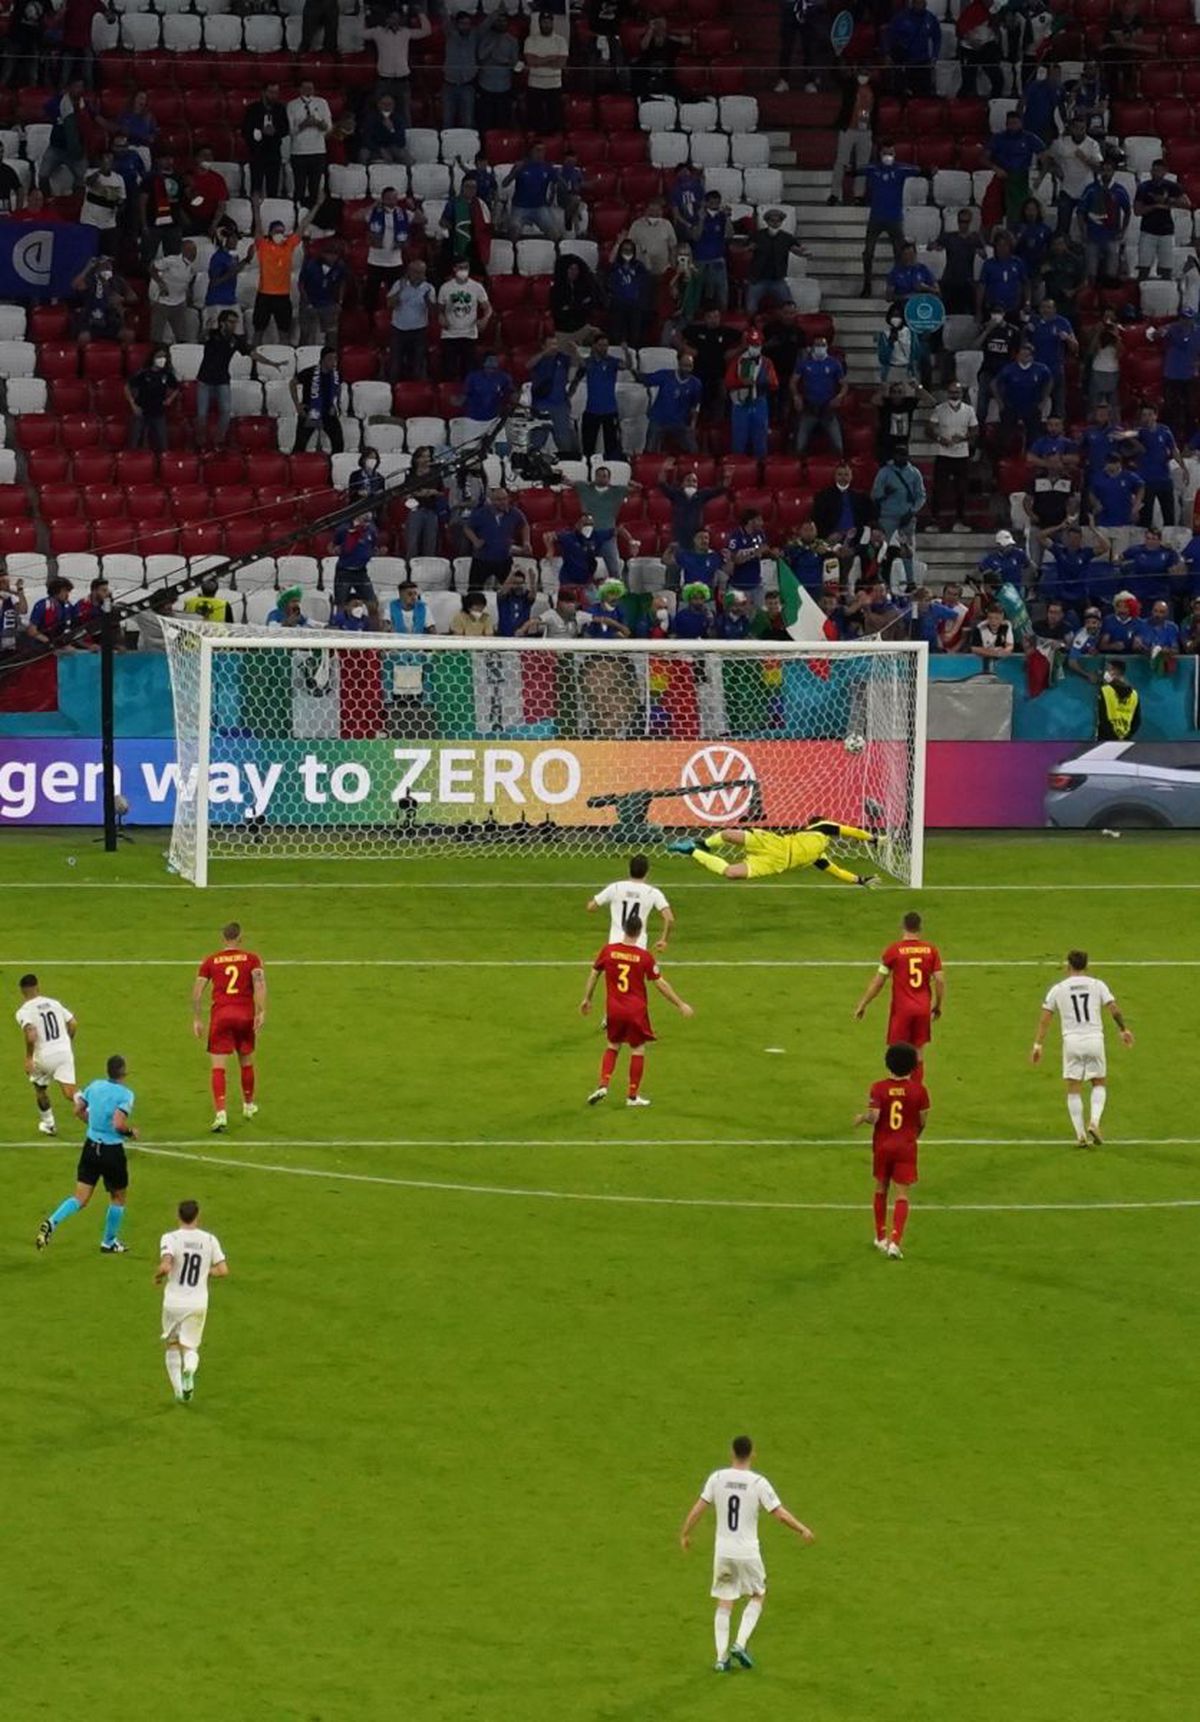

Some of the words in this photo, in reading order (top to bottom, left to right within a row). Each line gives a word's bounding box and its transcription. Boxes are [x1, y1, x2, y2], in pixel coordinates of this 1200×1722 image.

[0, 760, 122, 818] gen
[141, 762, 283, 818] way
[298, 754, 371, 804] to
[391, 748, 581, 804] ZERO
[225, 965, 239, 994] 2
[617, 963, 630, 993] 3
[909, 957, 922, 988] 5
[1070, 993, 1090, 1022] 17
[40, 1011, 60, 1041] 10
[890, 1100, 903, 1130] 6
[179, 1252, 202, 1287] 18
[727, 1494, 740, 1531] 8
